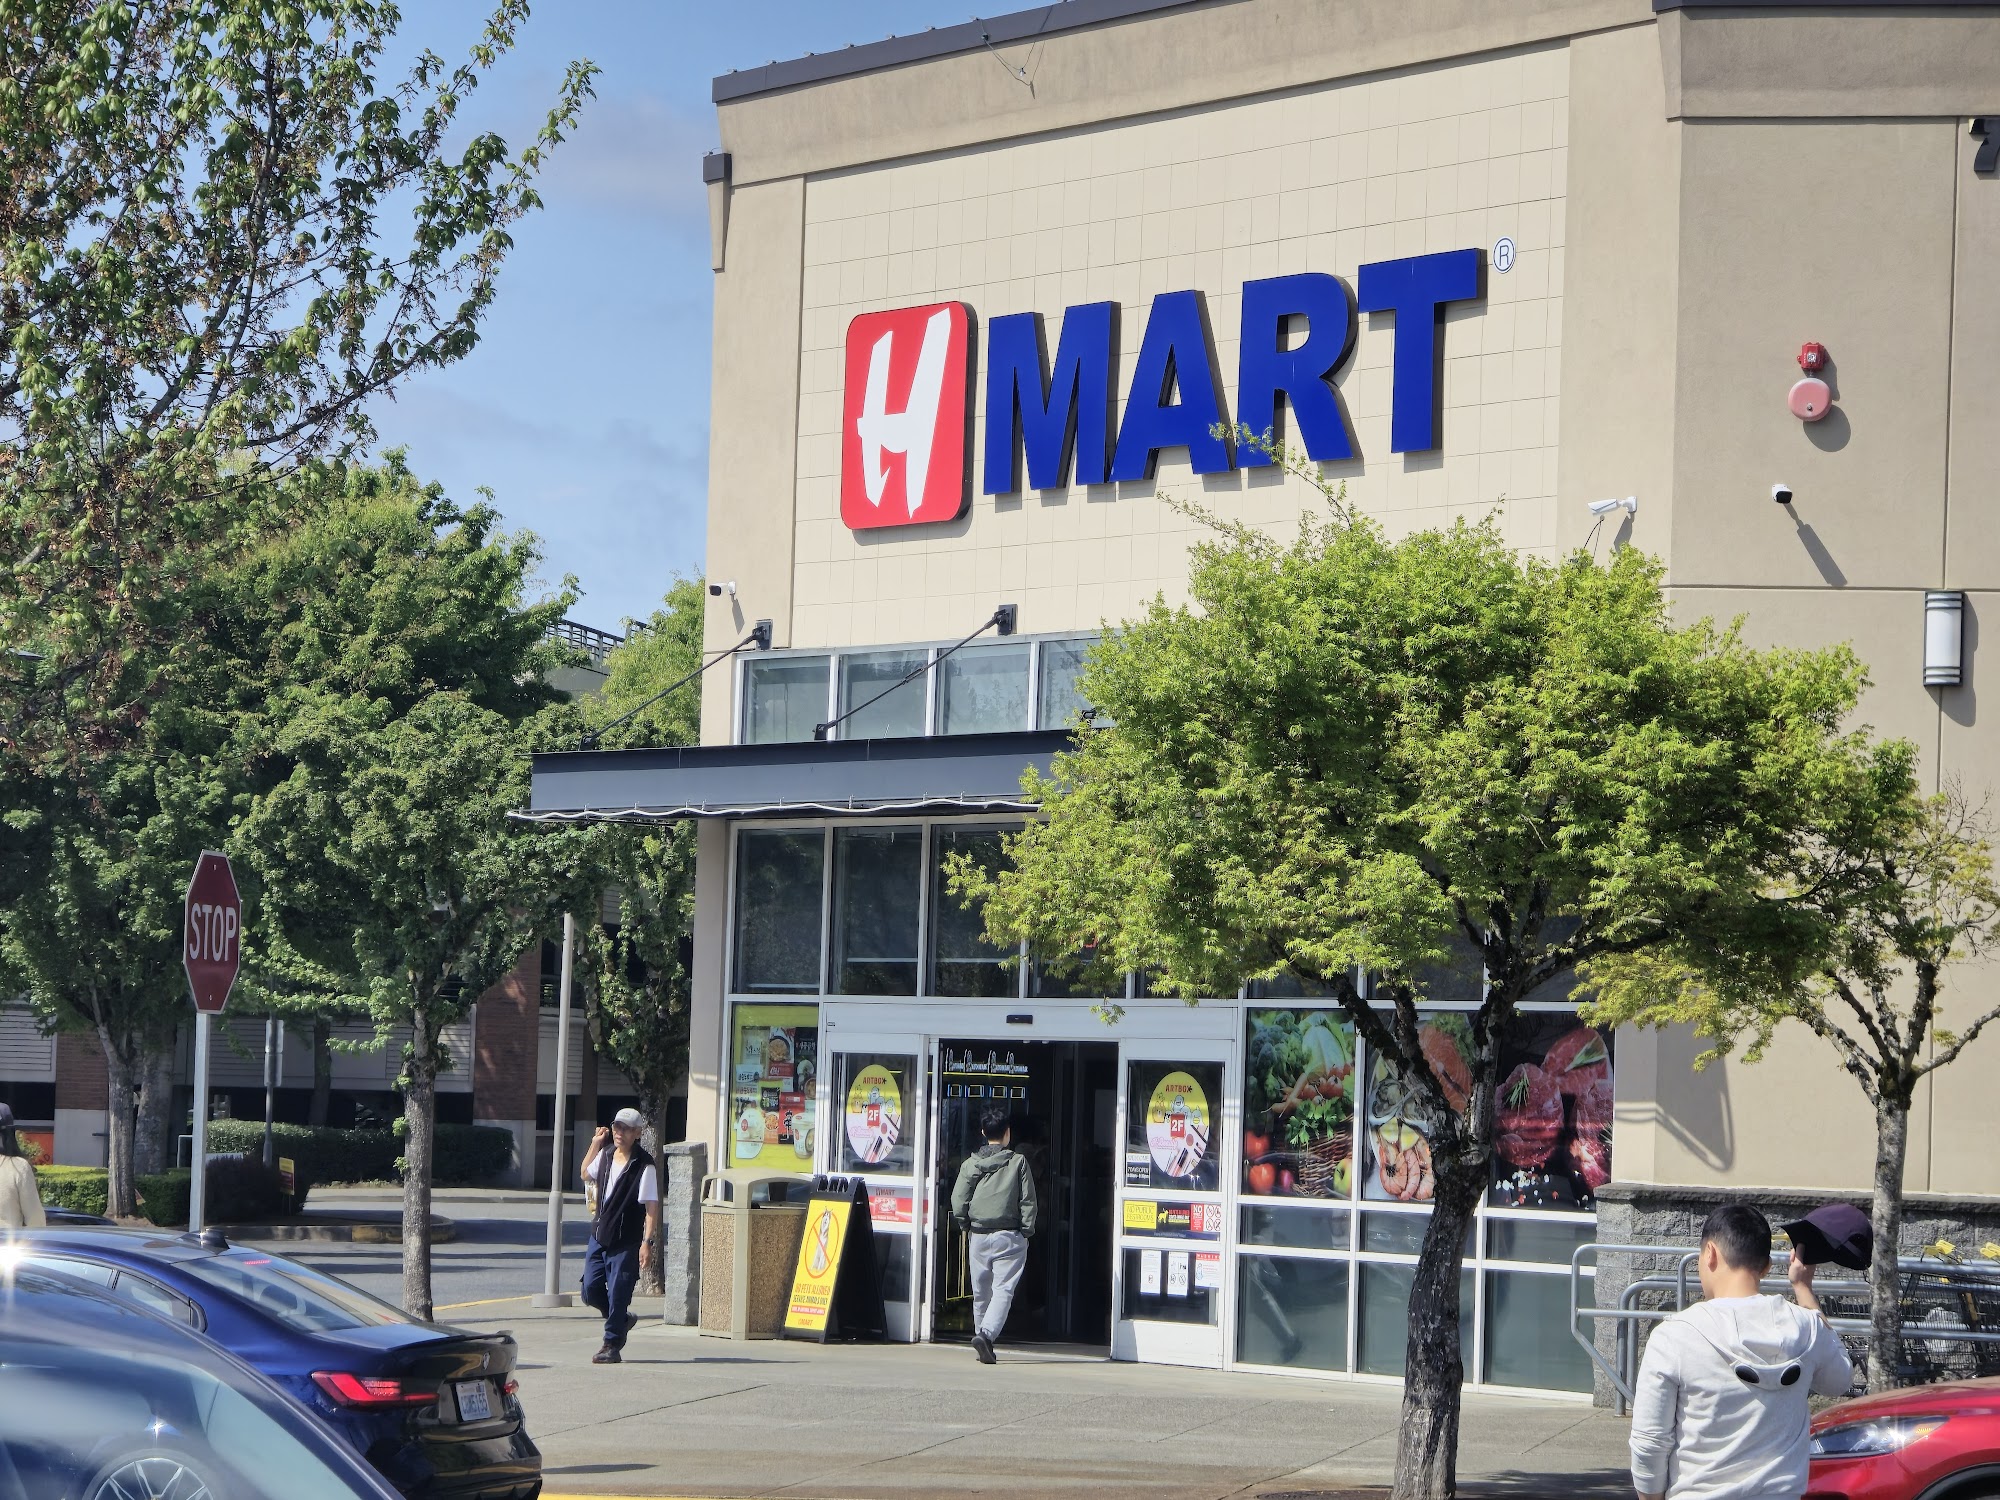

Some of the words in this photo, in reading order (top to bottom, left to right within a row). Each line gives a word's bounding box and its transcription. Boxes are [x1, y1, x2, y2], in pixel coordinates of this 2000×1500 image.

[857, 307, 952, 518] H
[983, 248, 1487, 495] MART
[190, 903, 237, 961] STOP
[863, 1076, 886, 1085] ARTBOX
[1165, 1084, 1192, 1093] ARTBOX
[868, 1110, 879, 1121] 2F
[1171, 1119, 1183, 1132] 2F
[1126, 1205, 1134, 1213] NO
[1135, 1206, 1154, 1214] PUBLIC
[1193, 1204, 1203, 1213] NO
